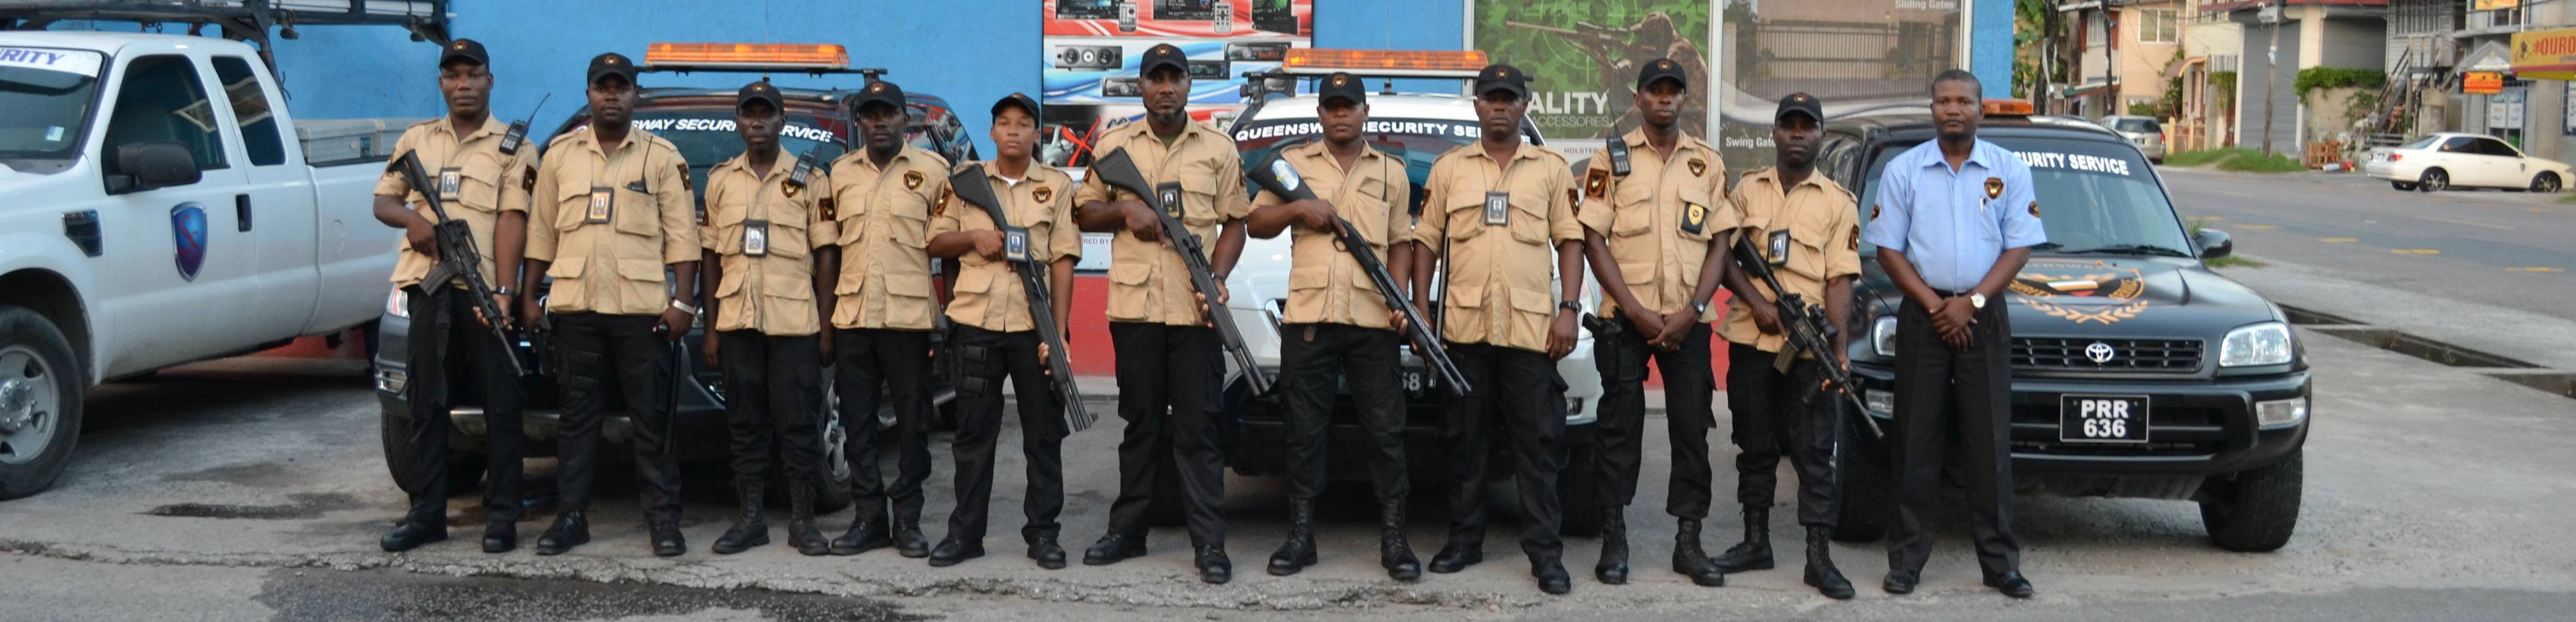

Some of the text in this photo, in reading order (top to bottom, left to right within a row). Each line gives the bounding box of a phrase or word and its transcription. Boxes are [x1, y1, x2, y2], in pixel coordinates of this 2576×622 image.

[1894, 0, 1927, 11] Sliding
[1532, 115, 1609, 127] ACCESSORIES
[779, 124, 833, 143] RVICE
[1726, 136, 1753, 150] Swing
[2068, 153, 2129, 176] SERVICE
[2081, 399, 2129, 419] PRR
[2084, 418, 2126, 438] 636
